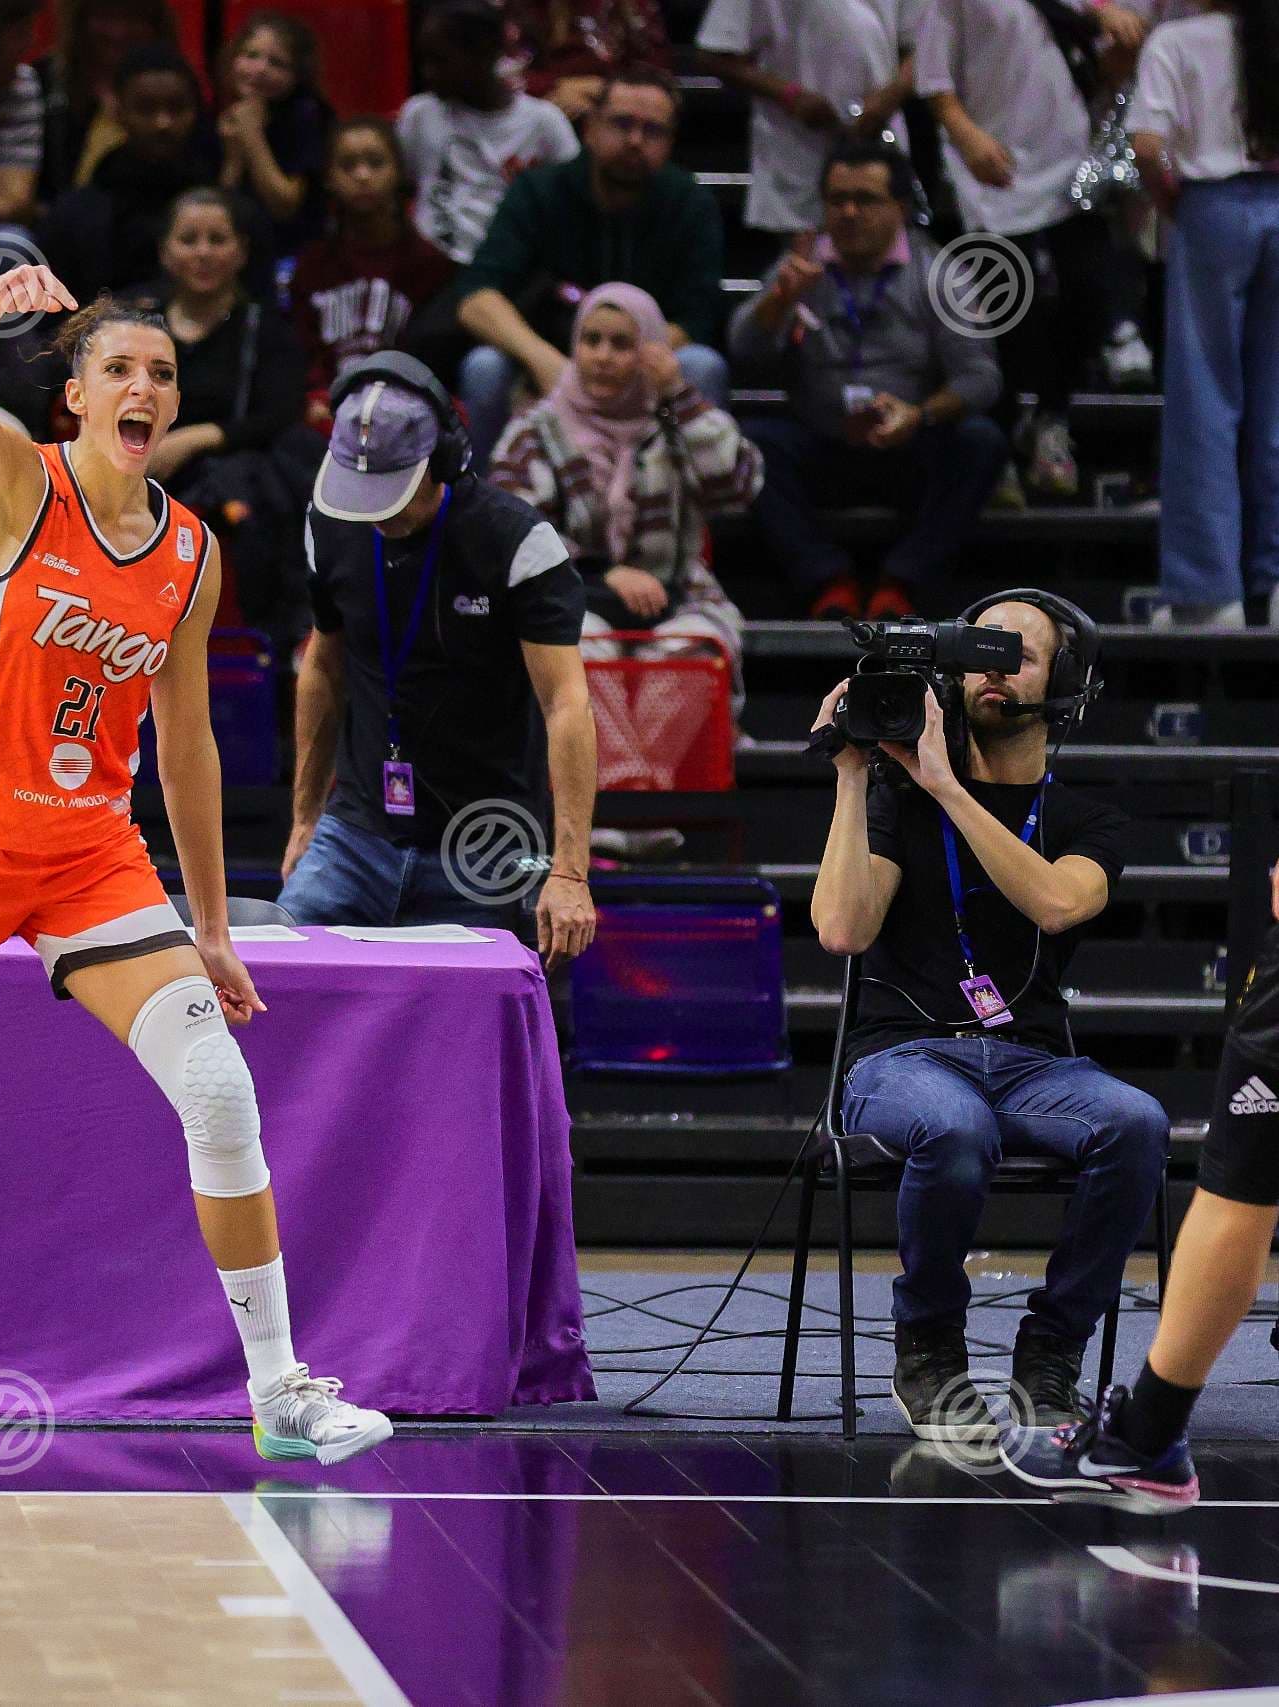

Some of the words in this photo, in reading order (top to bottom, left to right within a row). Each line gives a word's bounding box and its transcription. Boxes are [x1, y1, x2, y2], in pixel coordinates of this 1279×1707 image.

[32, 583, 168, 684] Tango
[51, 675, 106, 742] 21
[13, 788, 66, 808] KONICA
[67, 793, 110, 809] MINOLTA
